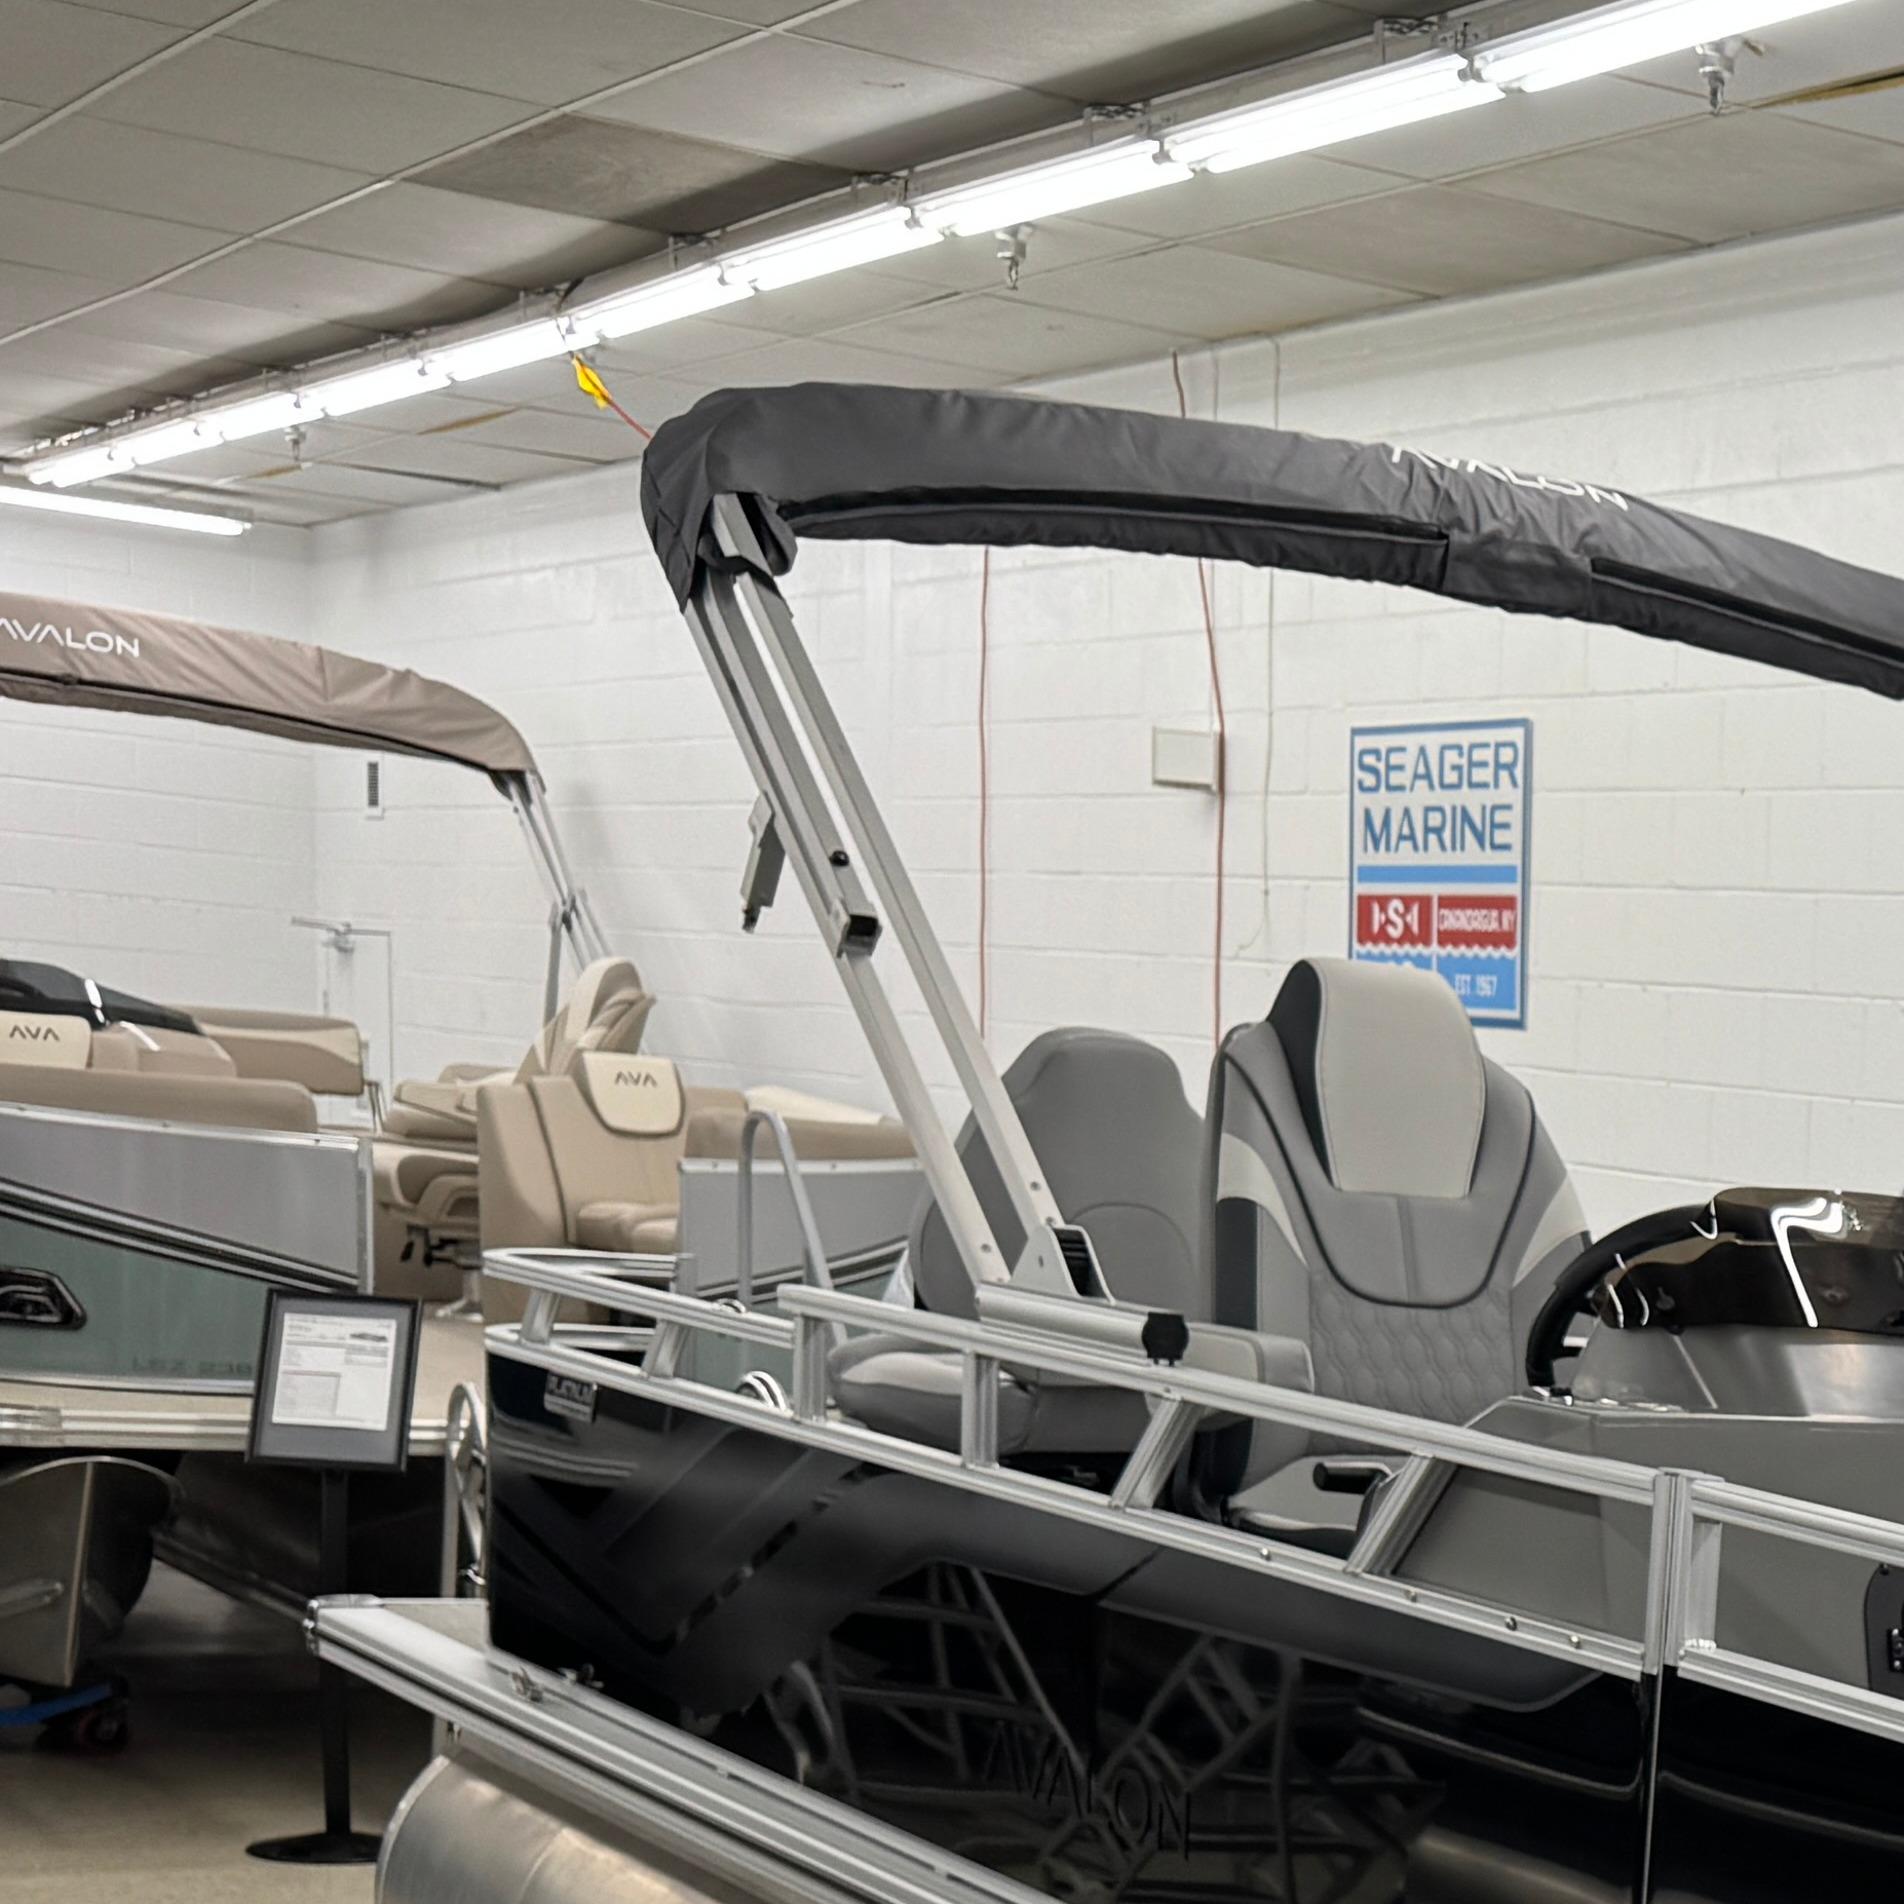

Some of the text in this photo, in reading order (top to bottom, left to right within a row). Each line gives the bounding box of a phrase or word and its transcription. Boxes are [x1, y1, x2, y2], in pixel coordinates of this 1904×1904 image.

[0, 617, 141, 658] AVALON
[1357, 741, 1519, 793] SEAGER
[1363, 804, 1514, 854] MARINE
[9, 1024, 60, 1042] AVA
[614, 1070, 658, 1088] AVA
